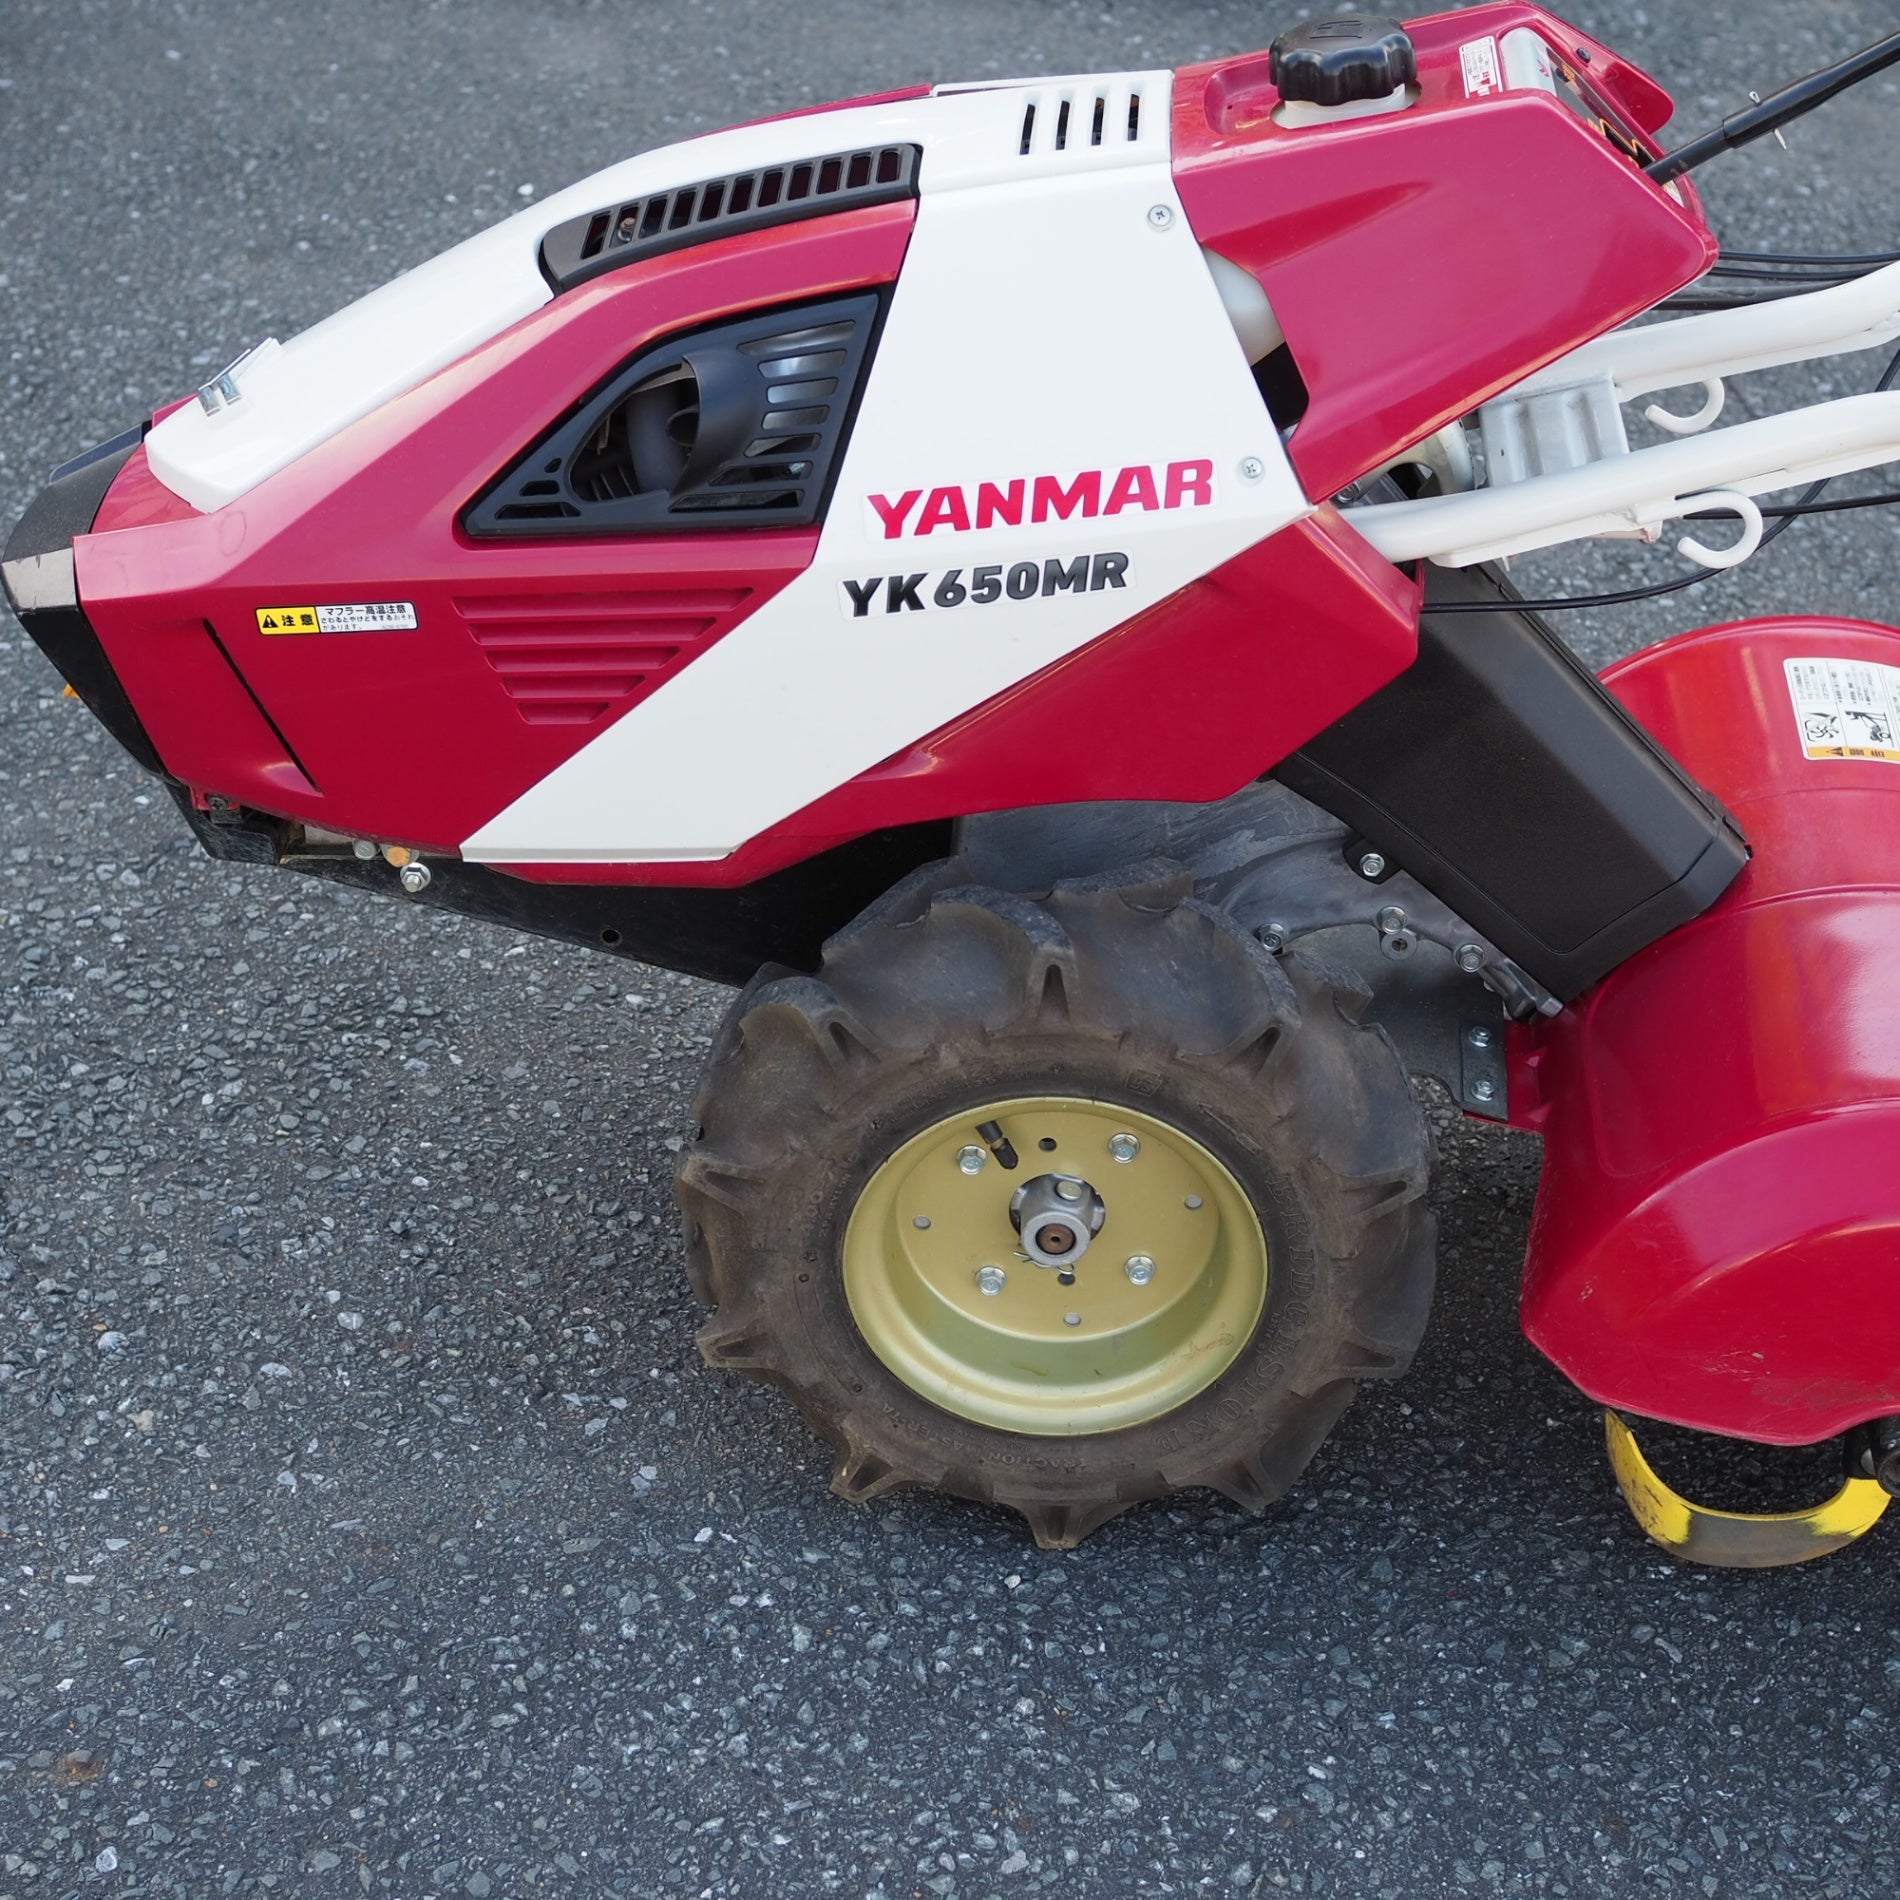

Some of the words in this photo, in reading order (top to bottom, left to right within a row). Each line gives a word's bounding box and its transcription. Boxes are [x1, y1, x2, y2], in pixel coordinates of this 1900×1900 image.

[867, 459, 1213, 540] YANMAR
[842, 552, 1129, 618] YK650MR
[281, 614, 314, 626] 注意
[325, 604, 406, 615] マフラー高温注意
[1152, 1175, 1315, 1456] BRIDGESTONE
[986, 1451, 1085, 1468] TRACTION
